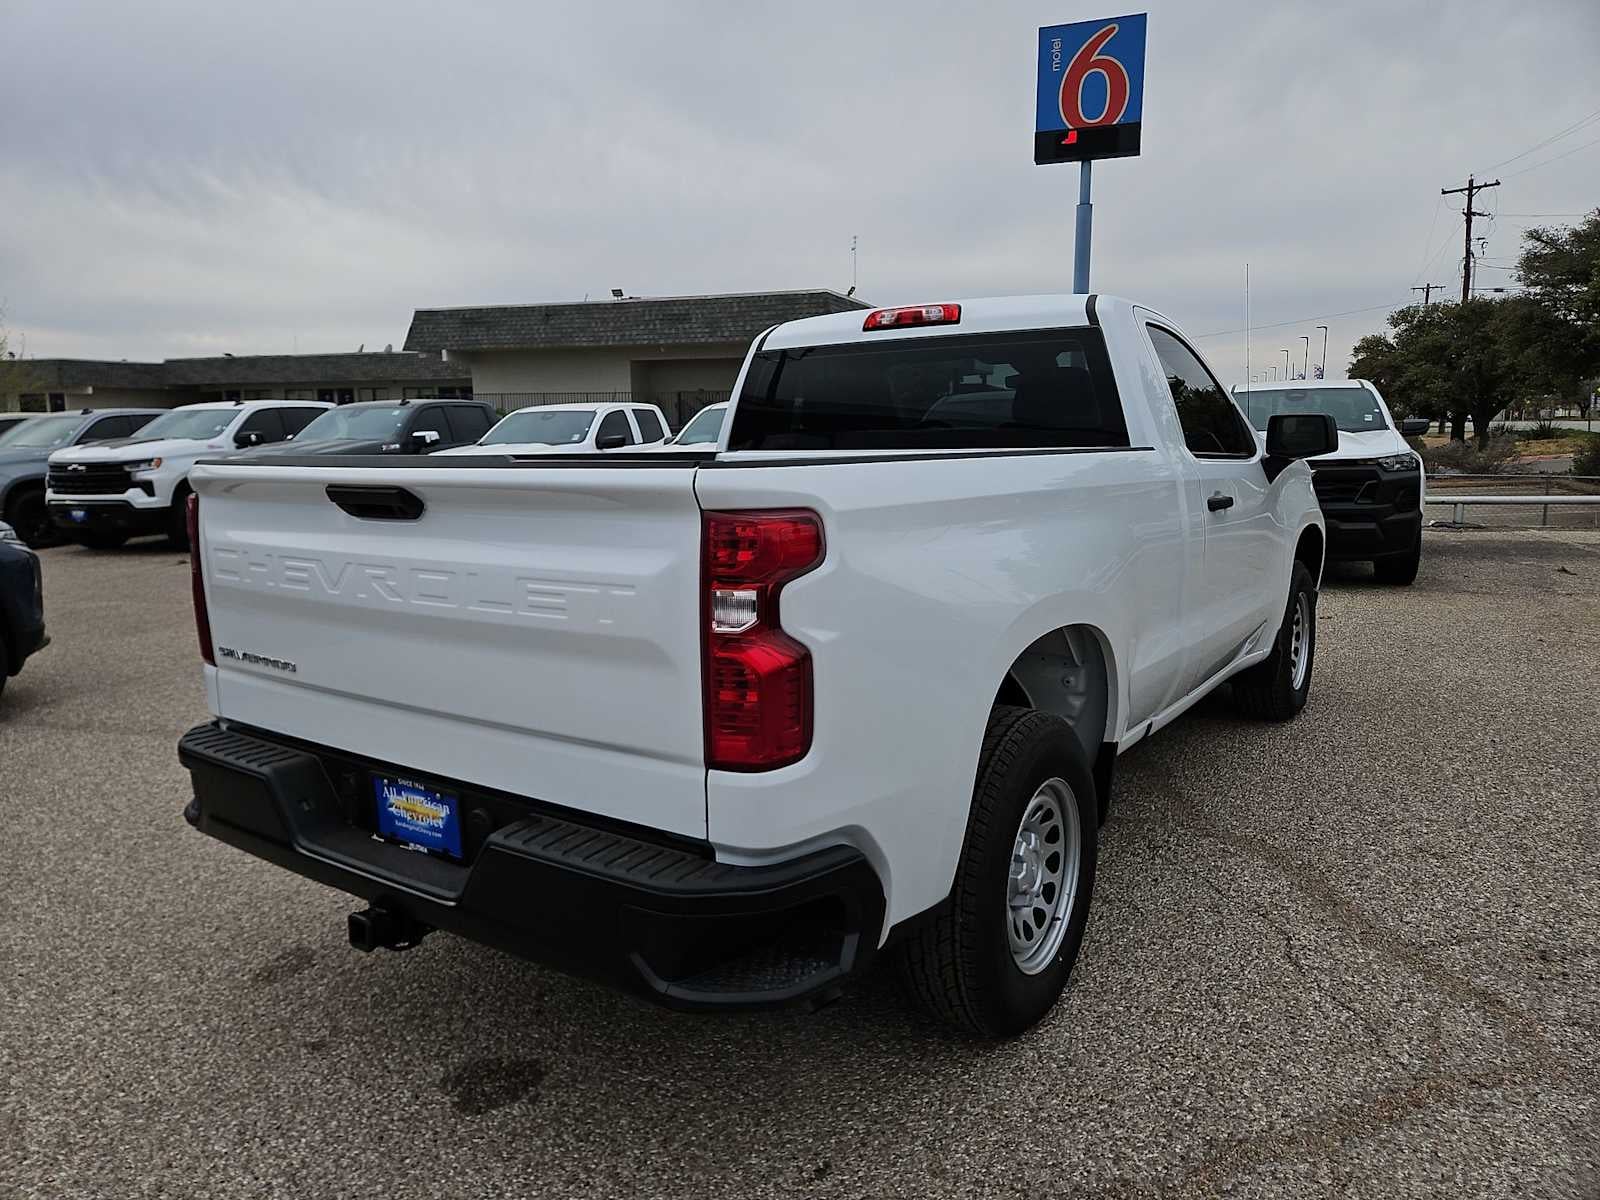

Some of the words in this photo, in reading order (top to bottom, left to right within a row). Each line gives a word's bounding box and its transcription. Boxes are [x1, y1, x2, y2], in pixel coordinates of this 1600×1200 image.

[1051, 38, 1061, 72] motel
[1058, 23, 1130, 129] 6
[213, 547, 636, 625] CHEVROLET
[218, 646, 297, 673] SILVERADO
[383, 786, 397, 798] All
